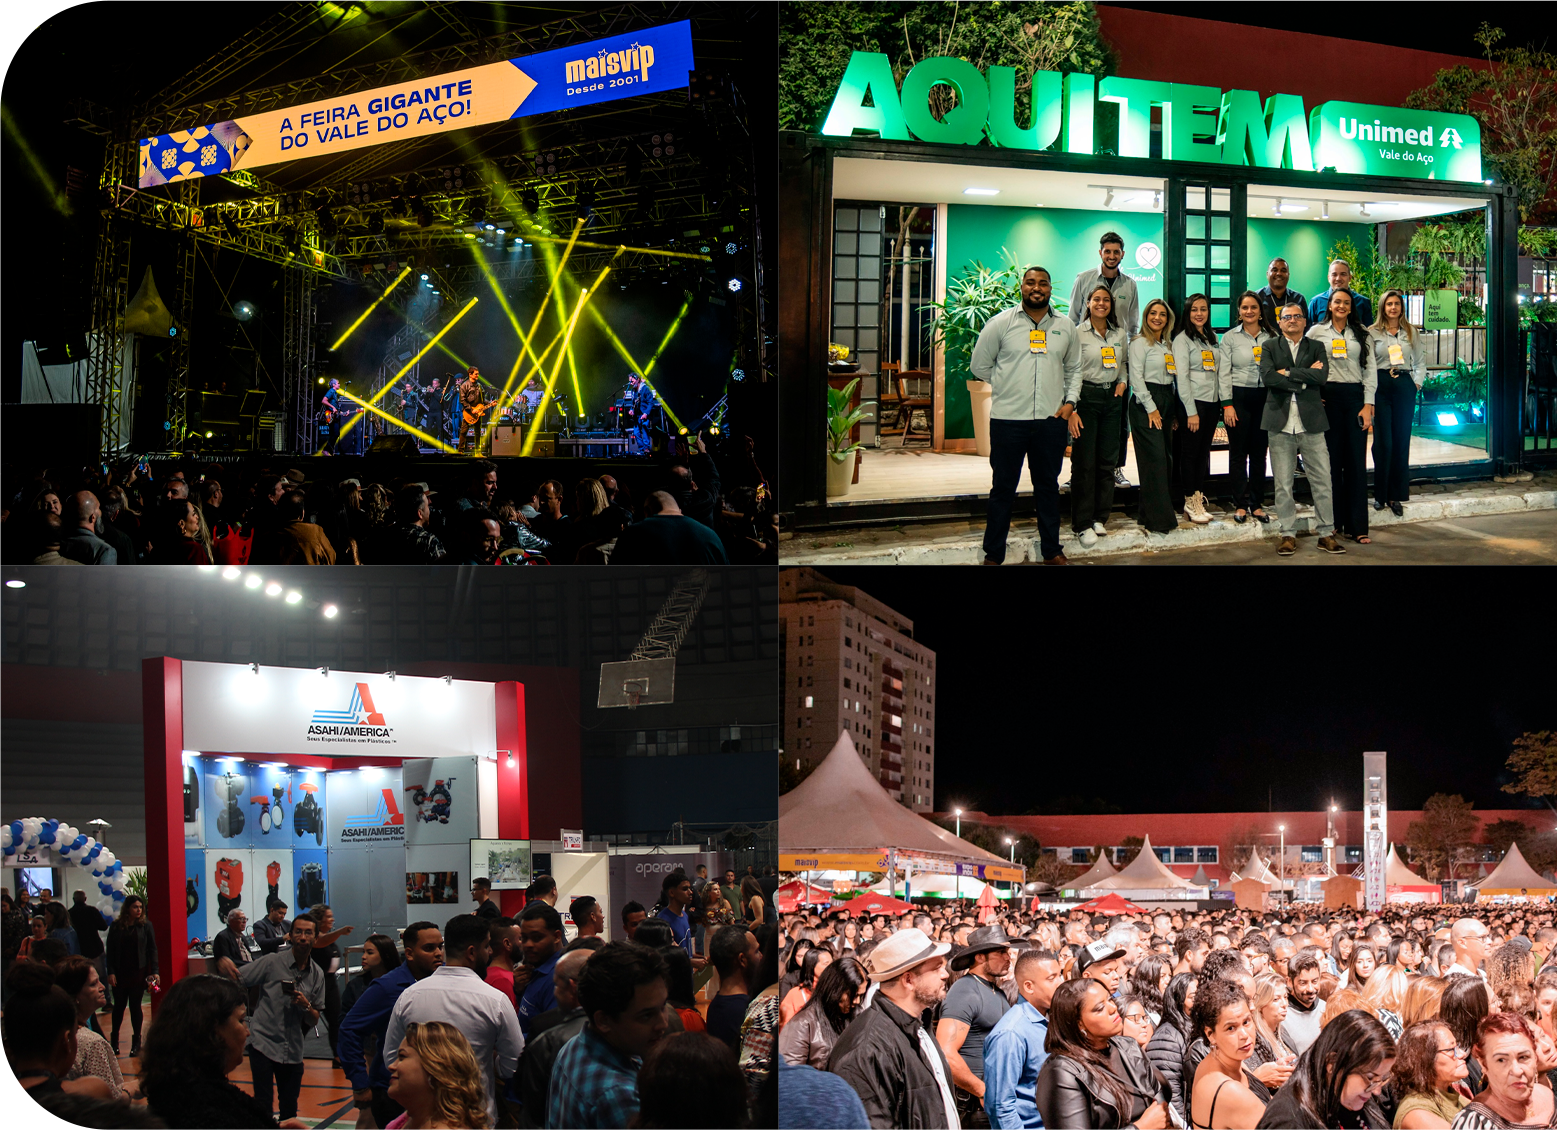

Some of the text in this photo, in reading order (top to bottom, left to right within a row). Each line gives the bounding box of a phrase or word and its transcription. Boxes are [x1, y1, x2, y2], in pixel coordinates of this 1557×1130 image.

[566, 74, 640, 97] Desde 2001
[279, 79, 473, 133] A FEIRA GIGANTE
[280, 99, 472, 151] DO VALE DO AÇO!
[1339, 116, 1434, 148] Unimed
[1379, 149, 1434, 165] Vale do Aço
[1428, 304, 1441, 312] Aqui
[1428, 316, 1451, 324] cuidado.
[307, 725, 391, 738] ASAHI/AMERICA
[17, 850, 39, 864] LSA
